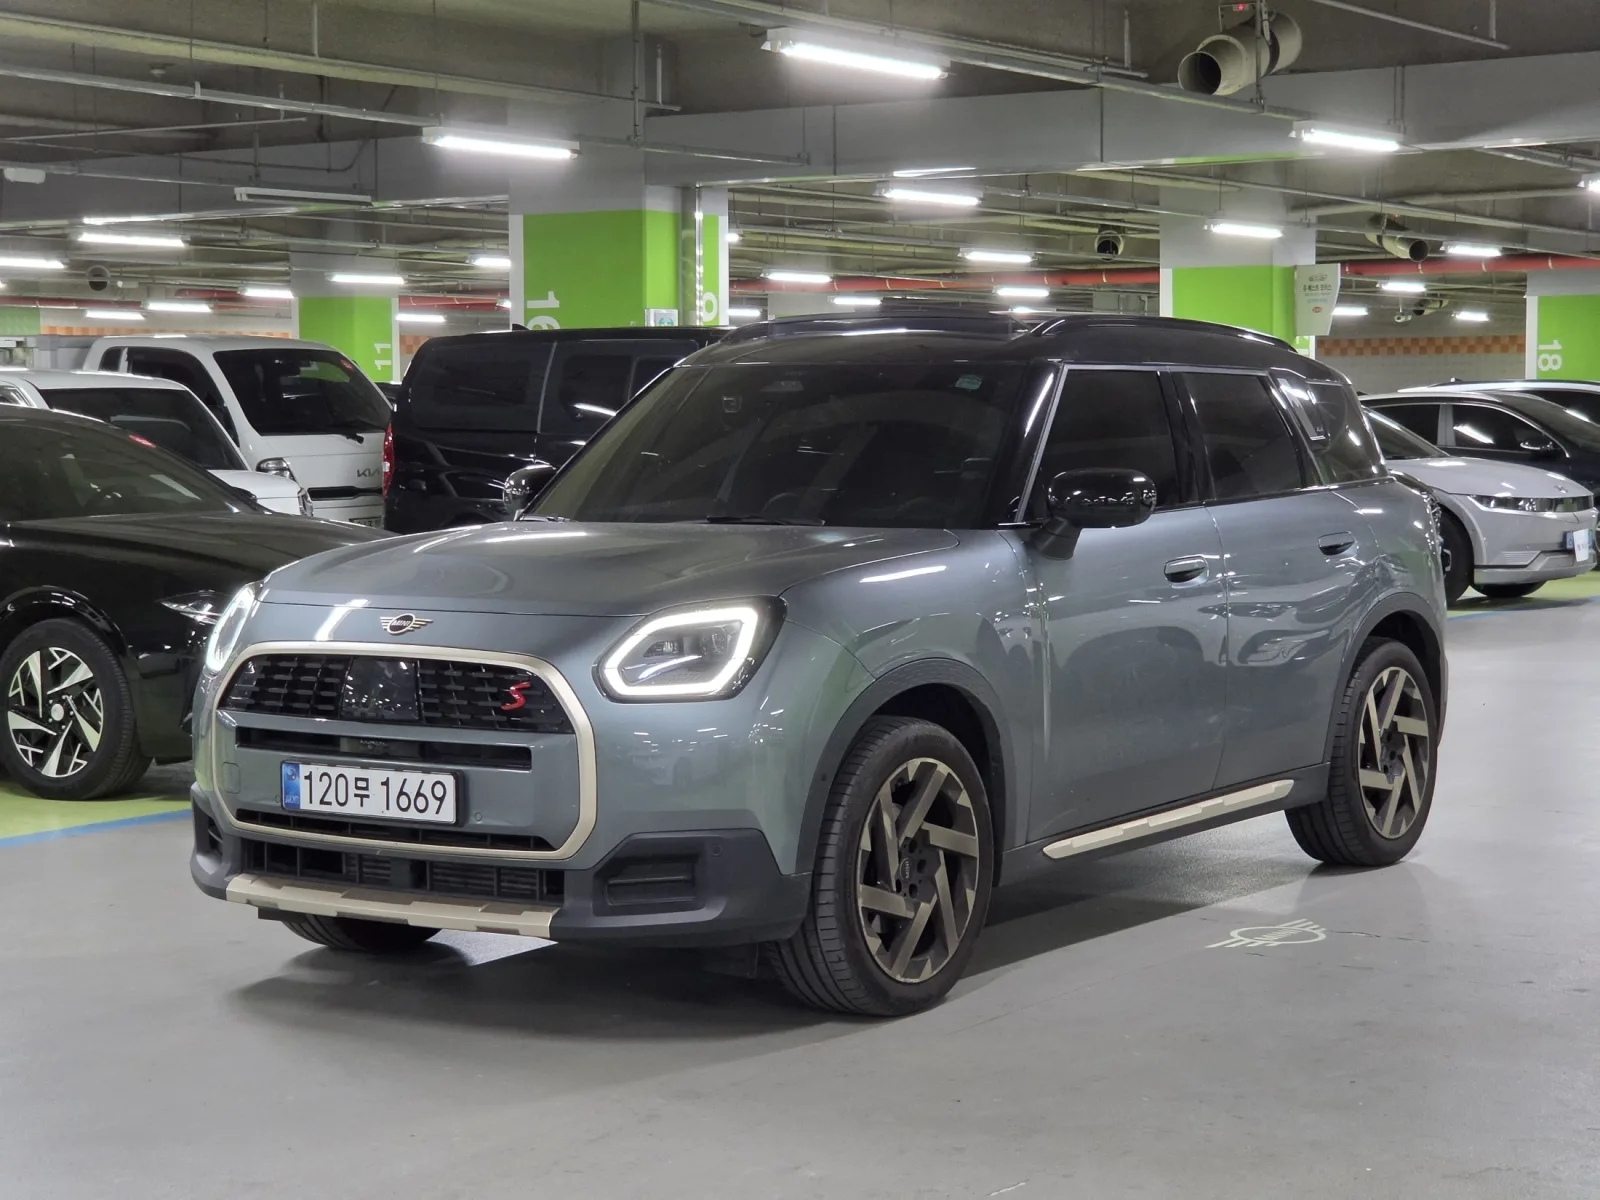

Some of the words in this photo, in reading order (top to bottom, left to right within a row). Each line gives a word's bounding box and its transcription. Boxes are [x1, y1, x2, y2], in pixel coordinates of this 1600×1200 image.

[373, 343, 392, 371] 11
[1537, 339, 1563, 372] 18
[501, 681, 532, 711] S
[303, 771, 370, 807] 120무
[380, 776, 447, 815] 1669
